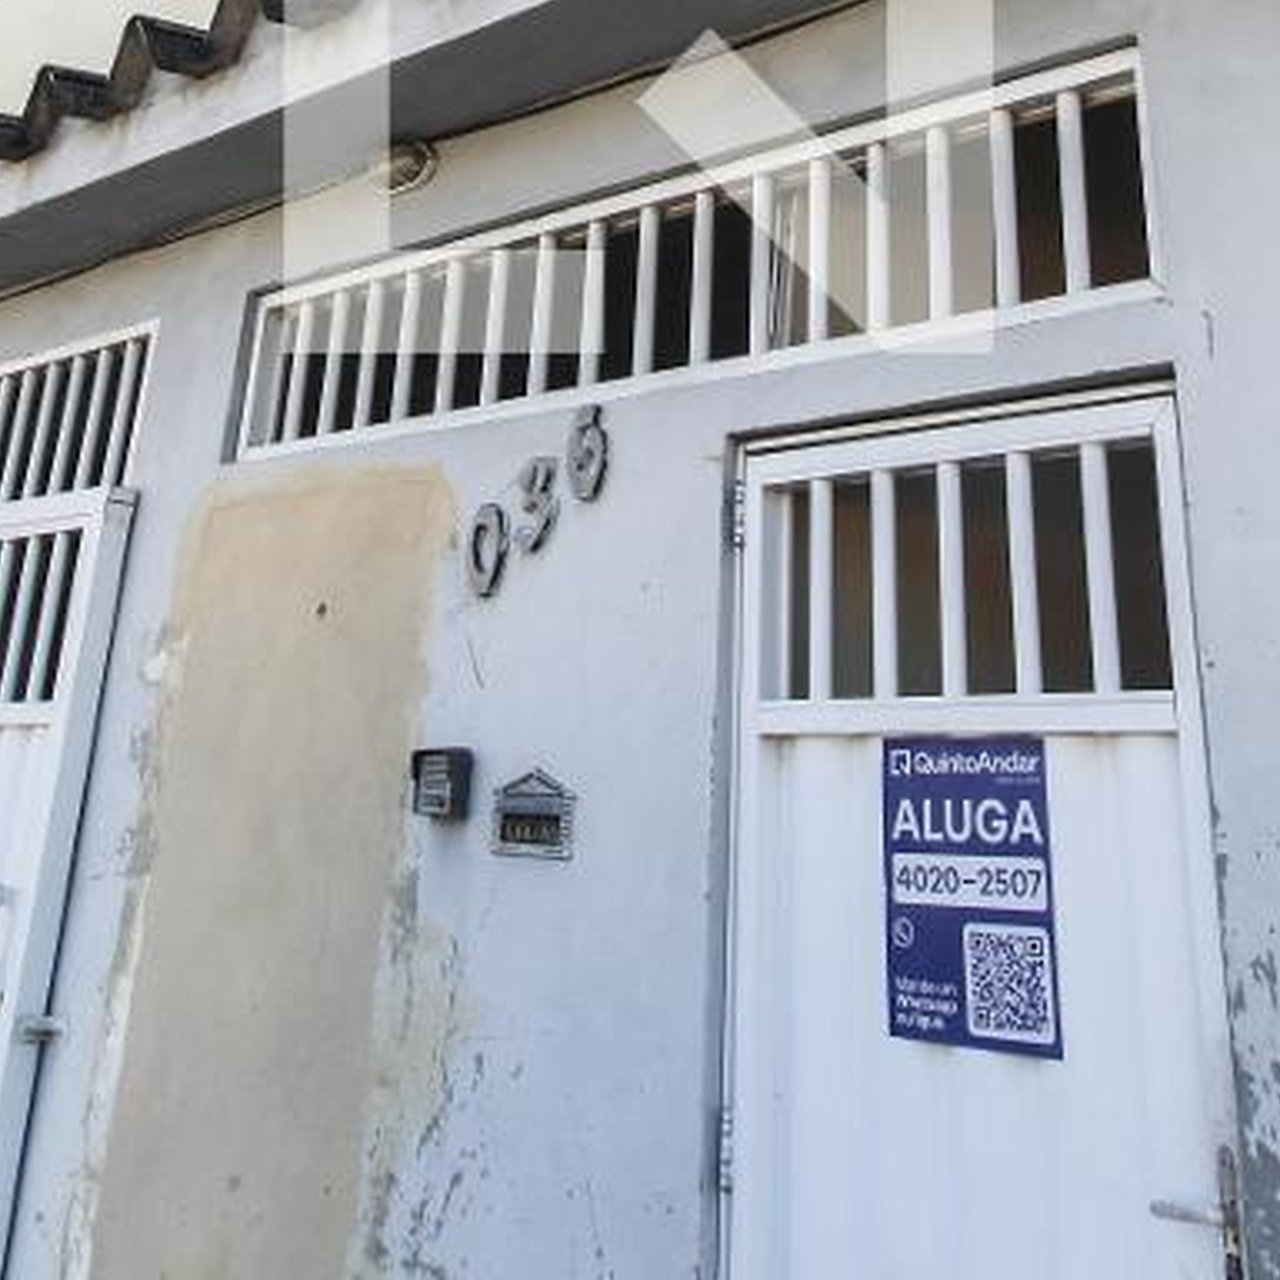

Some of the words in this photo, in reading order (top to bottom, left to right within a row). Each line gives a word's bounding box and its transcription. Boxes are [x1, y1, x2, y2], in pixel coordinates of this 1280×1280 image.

[914, 751, 1040, 775] QuintoAndar
[892, 798, 1044, 845] ALUGA
[896, 865, 1042, 899] 4020-2507
